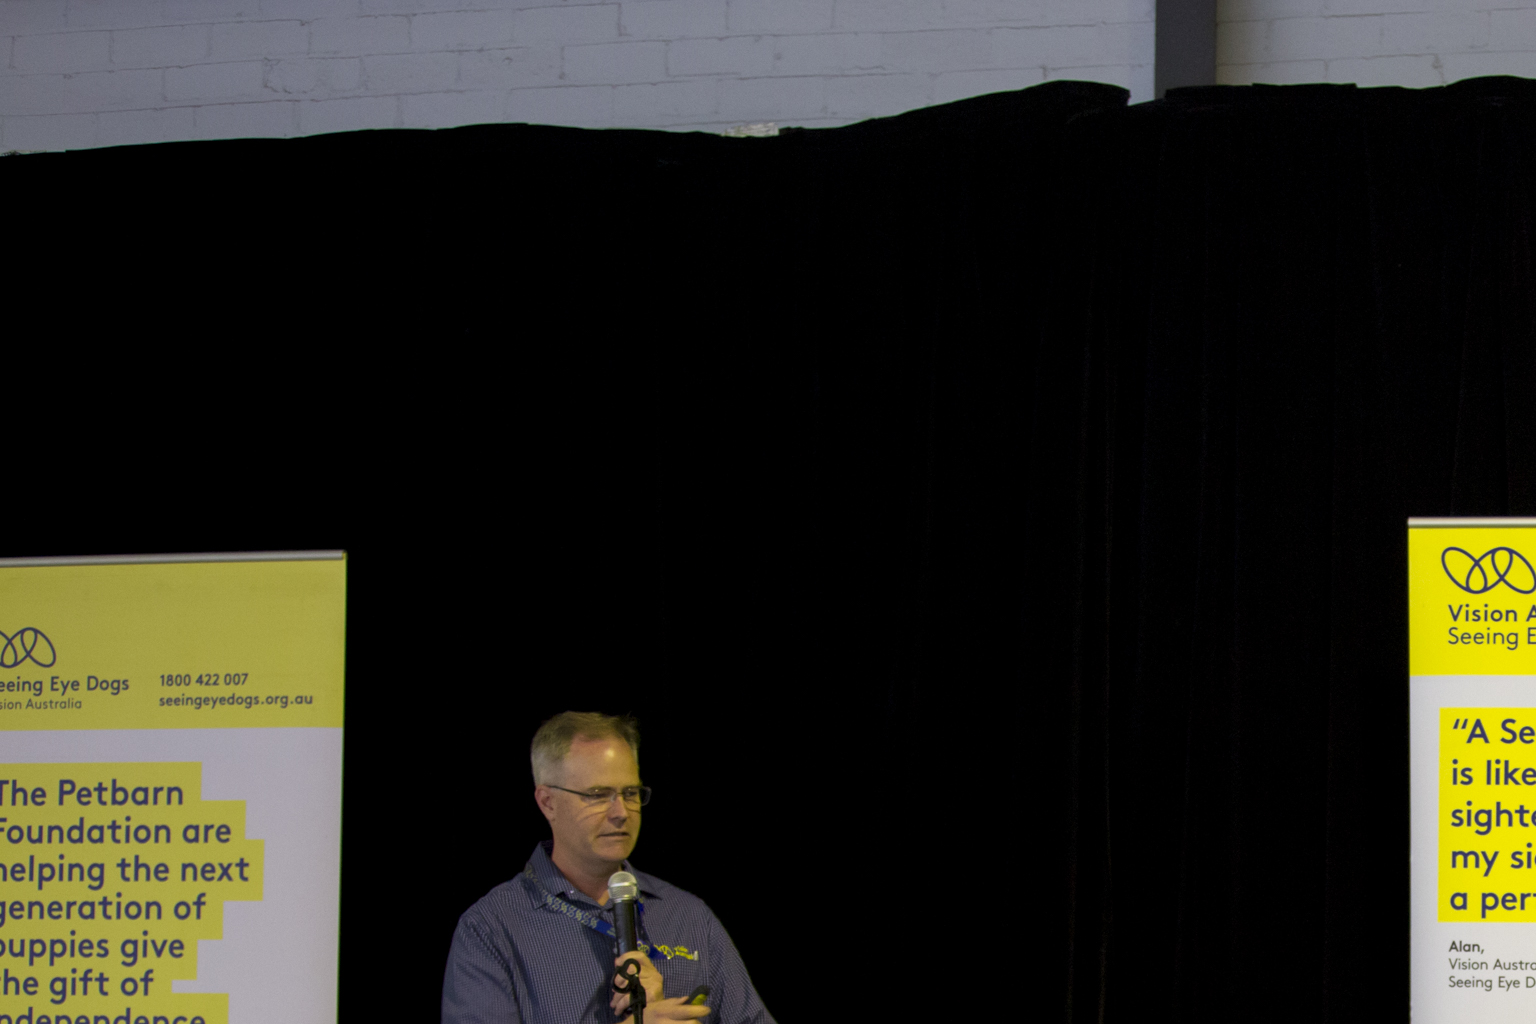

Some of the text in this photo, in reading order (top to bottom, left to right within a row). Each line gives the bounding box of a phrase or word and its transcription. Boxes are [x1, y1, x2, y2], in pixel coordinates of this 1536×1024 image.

[1448, 603, 1518, 622] Vision
[1447, 626, 1519, 651] Seeing
[50, 675, 80, 697] Eye
[86, 675, 130, 696] Dogs
[159, 672, 249, 687] 1800 422 007
[25, 697, 82, 710] Australia
[159, 692, 313, 710] seeingeyedogs.org.au
[1452, 758, 1474, 786] is
[0, 778, 183, 807] The Petbarn
[182, 824, 232, 844] are
[116, 854, 170, 882] the
[181, 857, 250, 882] next
[1451, 850, 1499, 877] my
[0, 891, 207, 928] eneration of
[1450, 892, 1468, 911] a
[120, 929, 185, 968] give
[1448, 940, 1485, 955] Alan,
[1448, 957, 1489, 971] Vision
[0, 967, 154, 1005] he gift of
[1448, 975, 1493, 992] Seeing
[1498, 975, 1521, 992] Eye
